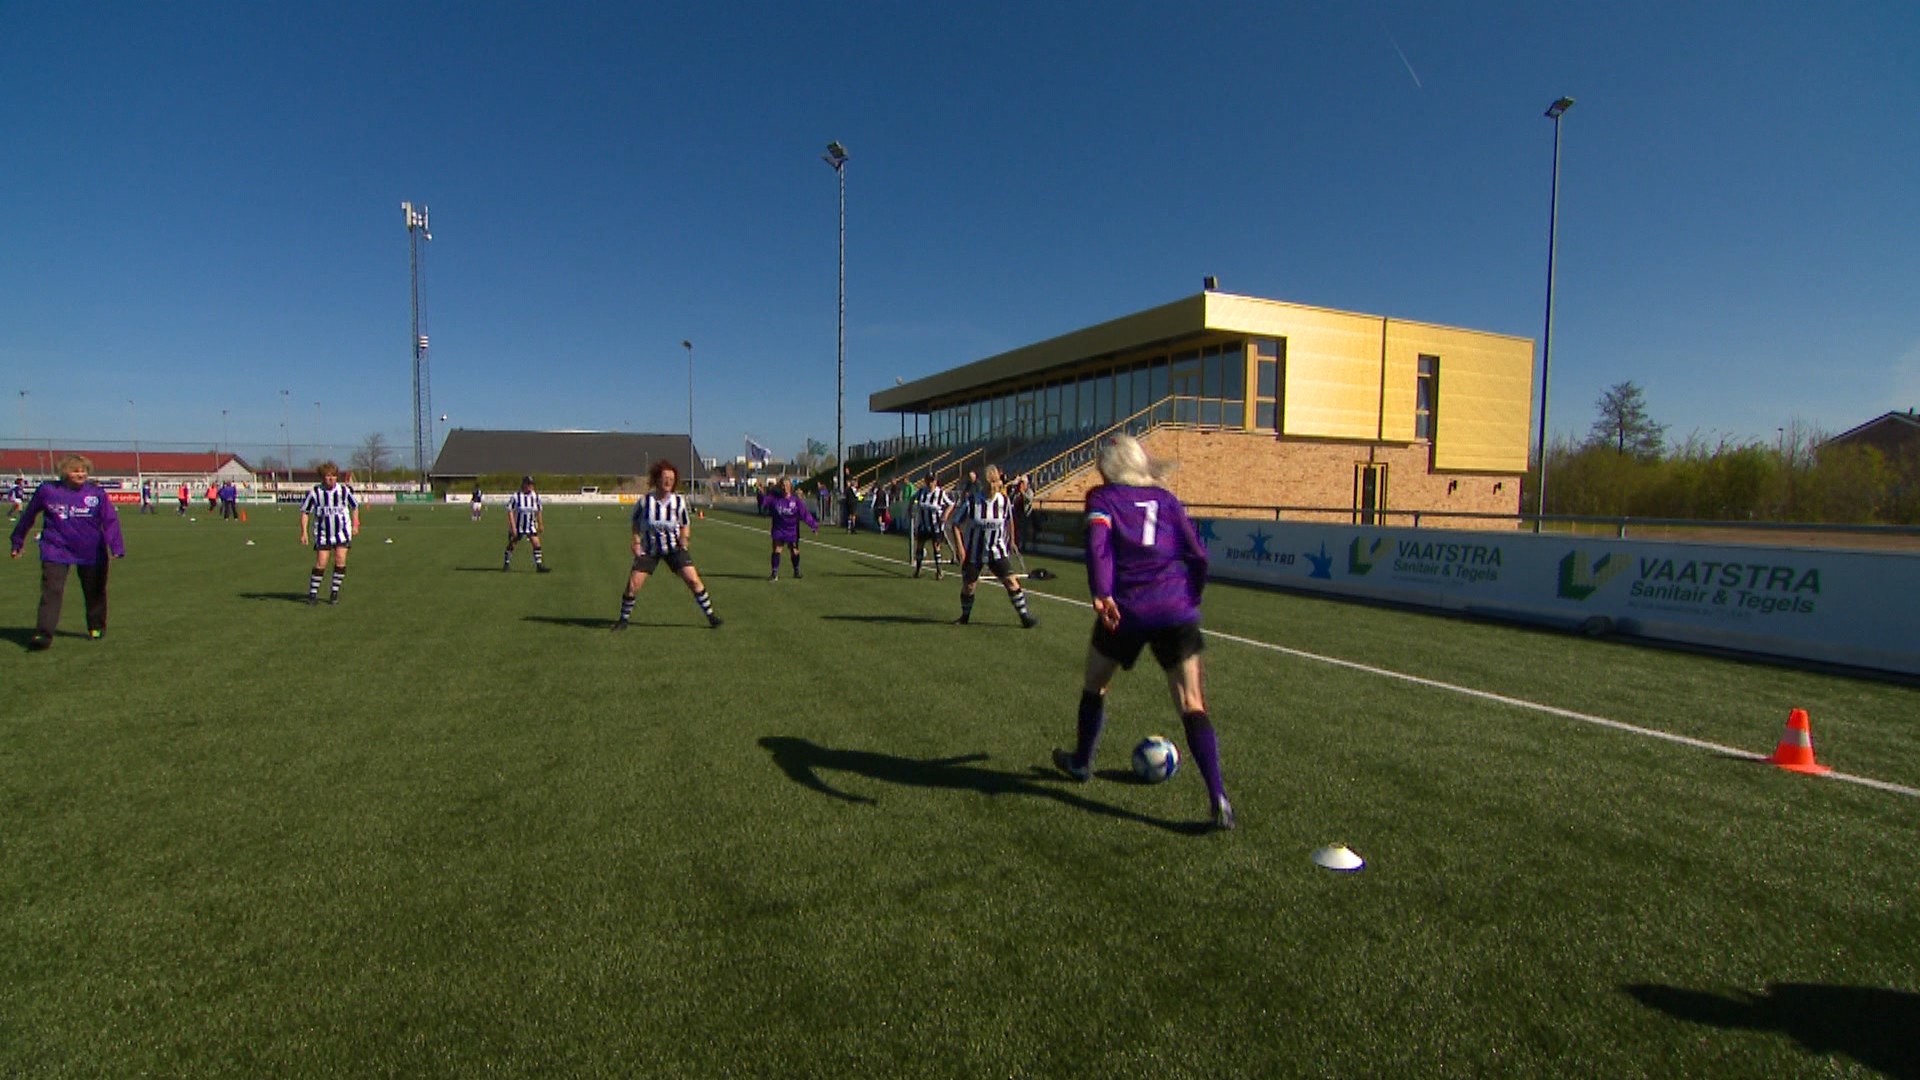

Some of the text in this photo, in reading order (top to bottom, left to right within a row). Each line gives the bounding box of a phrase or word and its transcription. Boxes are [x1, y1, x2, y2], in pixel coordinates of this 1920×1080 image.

[1398, 540, 1501, 567] VAATSTRA
[1393, 558, 1440, 576] Sanitair
[1441, 563, 1451, 577] &
[1455, 564, 1498, 583] Tegels
[1640, 556, 1822, 594] VAATSTRA
[1630, 579, 1709, 603] Sanitair
[1711, 589, 1728, 605] &
[1736, 590, 1816, 614] Tegels
